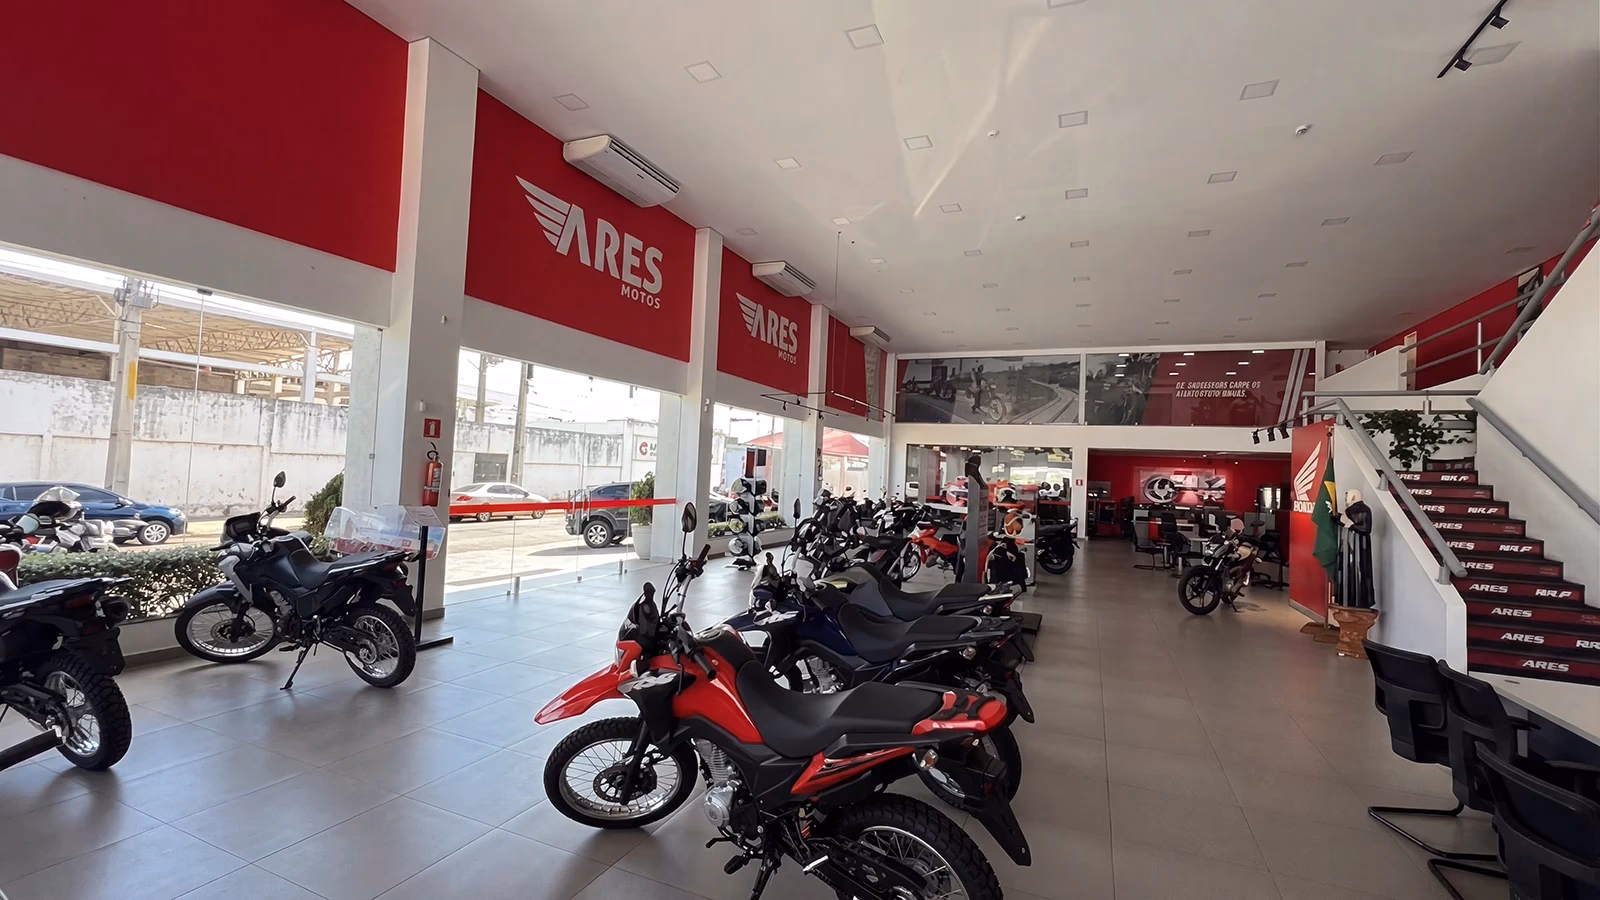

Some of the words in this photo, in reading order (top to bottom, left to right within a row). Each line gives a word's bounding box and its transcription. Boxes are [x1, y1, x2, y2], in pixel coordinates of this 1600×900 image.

[556, 204, 663, 294] ARES
[621, 284, 661, 309] MOTOS
[751, 303, 798, 354] ARES
[778, 350, 797, 365] MOTOS
[1469, 583, 1508, 594] ARES
[1491, 607, 1532, 618] ARES
[1501, 632, 1545, 645] ARES
[1522, 660, 1569, 673] ARES
